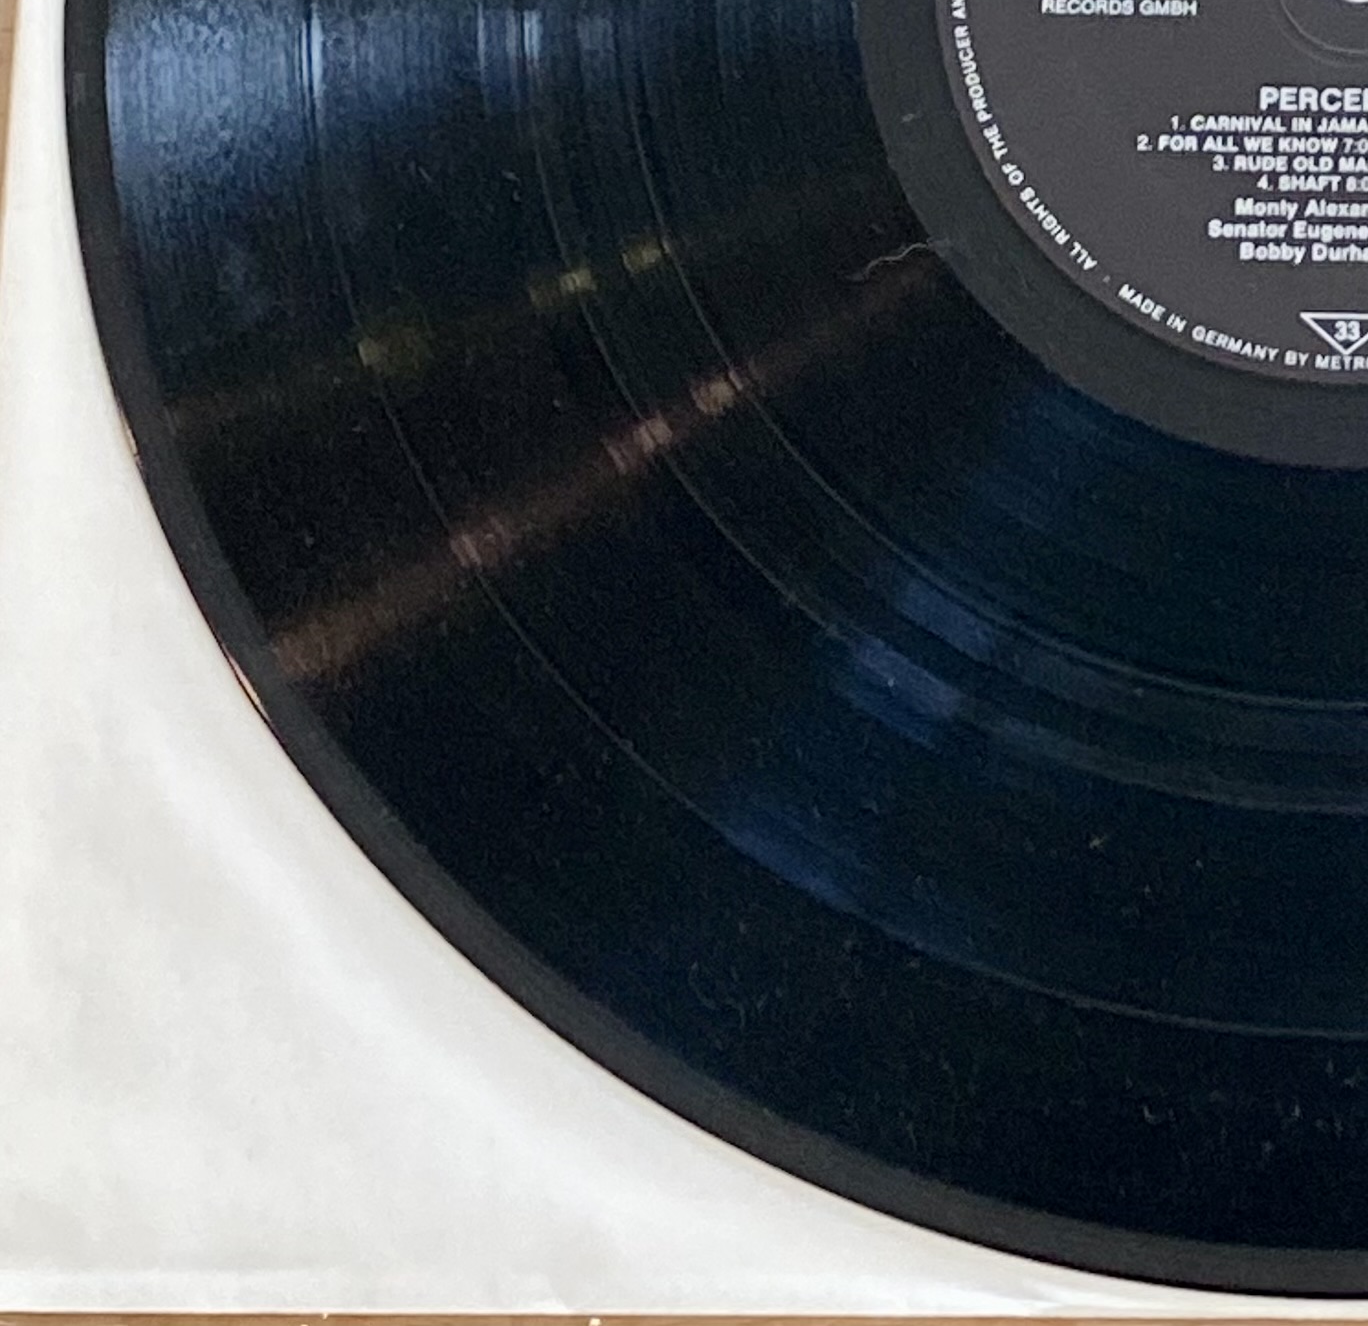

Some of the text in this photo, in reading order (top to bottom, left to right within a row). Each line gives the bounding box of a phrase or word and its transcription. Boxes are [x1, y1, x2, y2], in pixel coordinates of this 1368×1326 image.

[1138, 0, 1198, 16] GMBH
[954, 25, 993, 123] PRODUCER
[1170, 114, 1186, 131] 1.
[1189, 114, 1286, 133] CARNIVAL
[1291, 116, 1312, 133] IN
[983, 124, 1008, 161] THE
[1136, 134, 1153, 151] 2.
[1157, 134, 1198, 152] FOR
[1202, 136, 1239, 152] ALL
[1243, 136, 1274, 153] WE
[1279, 136, 1338, 152] KNOW
[1212, 154, 1229, 172] 3.
[1233, 155, 1289, 172] RUDE
[1292, 155, 1334, 172] OLD
[1001, 163, 1024, 186] OF
[1256, 174, 1274, 191] 4.
[1278, 175, 1342, 192] SHAFT
[1019, 186, 1070, 245] RIGHTS
[1234, 197, 1299, 220] Monty
[1207, 218, 1289, 239] Senator
[1069, 241, 1098, 270] ALL
[1240, 242, 1306, 264] Bobby
[1118, 284, 1166, 321] MADE
[1166, 313, 1187, 333] IN
[1191, 325, 1279, 361] GERMANY
[1284, 349, 1309, 366] BY
[1333, 320, 1361, 341] 33
